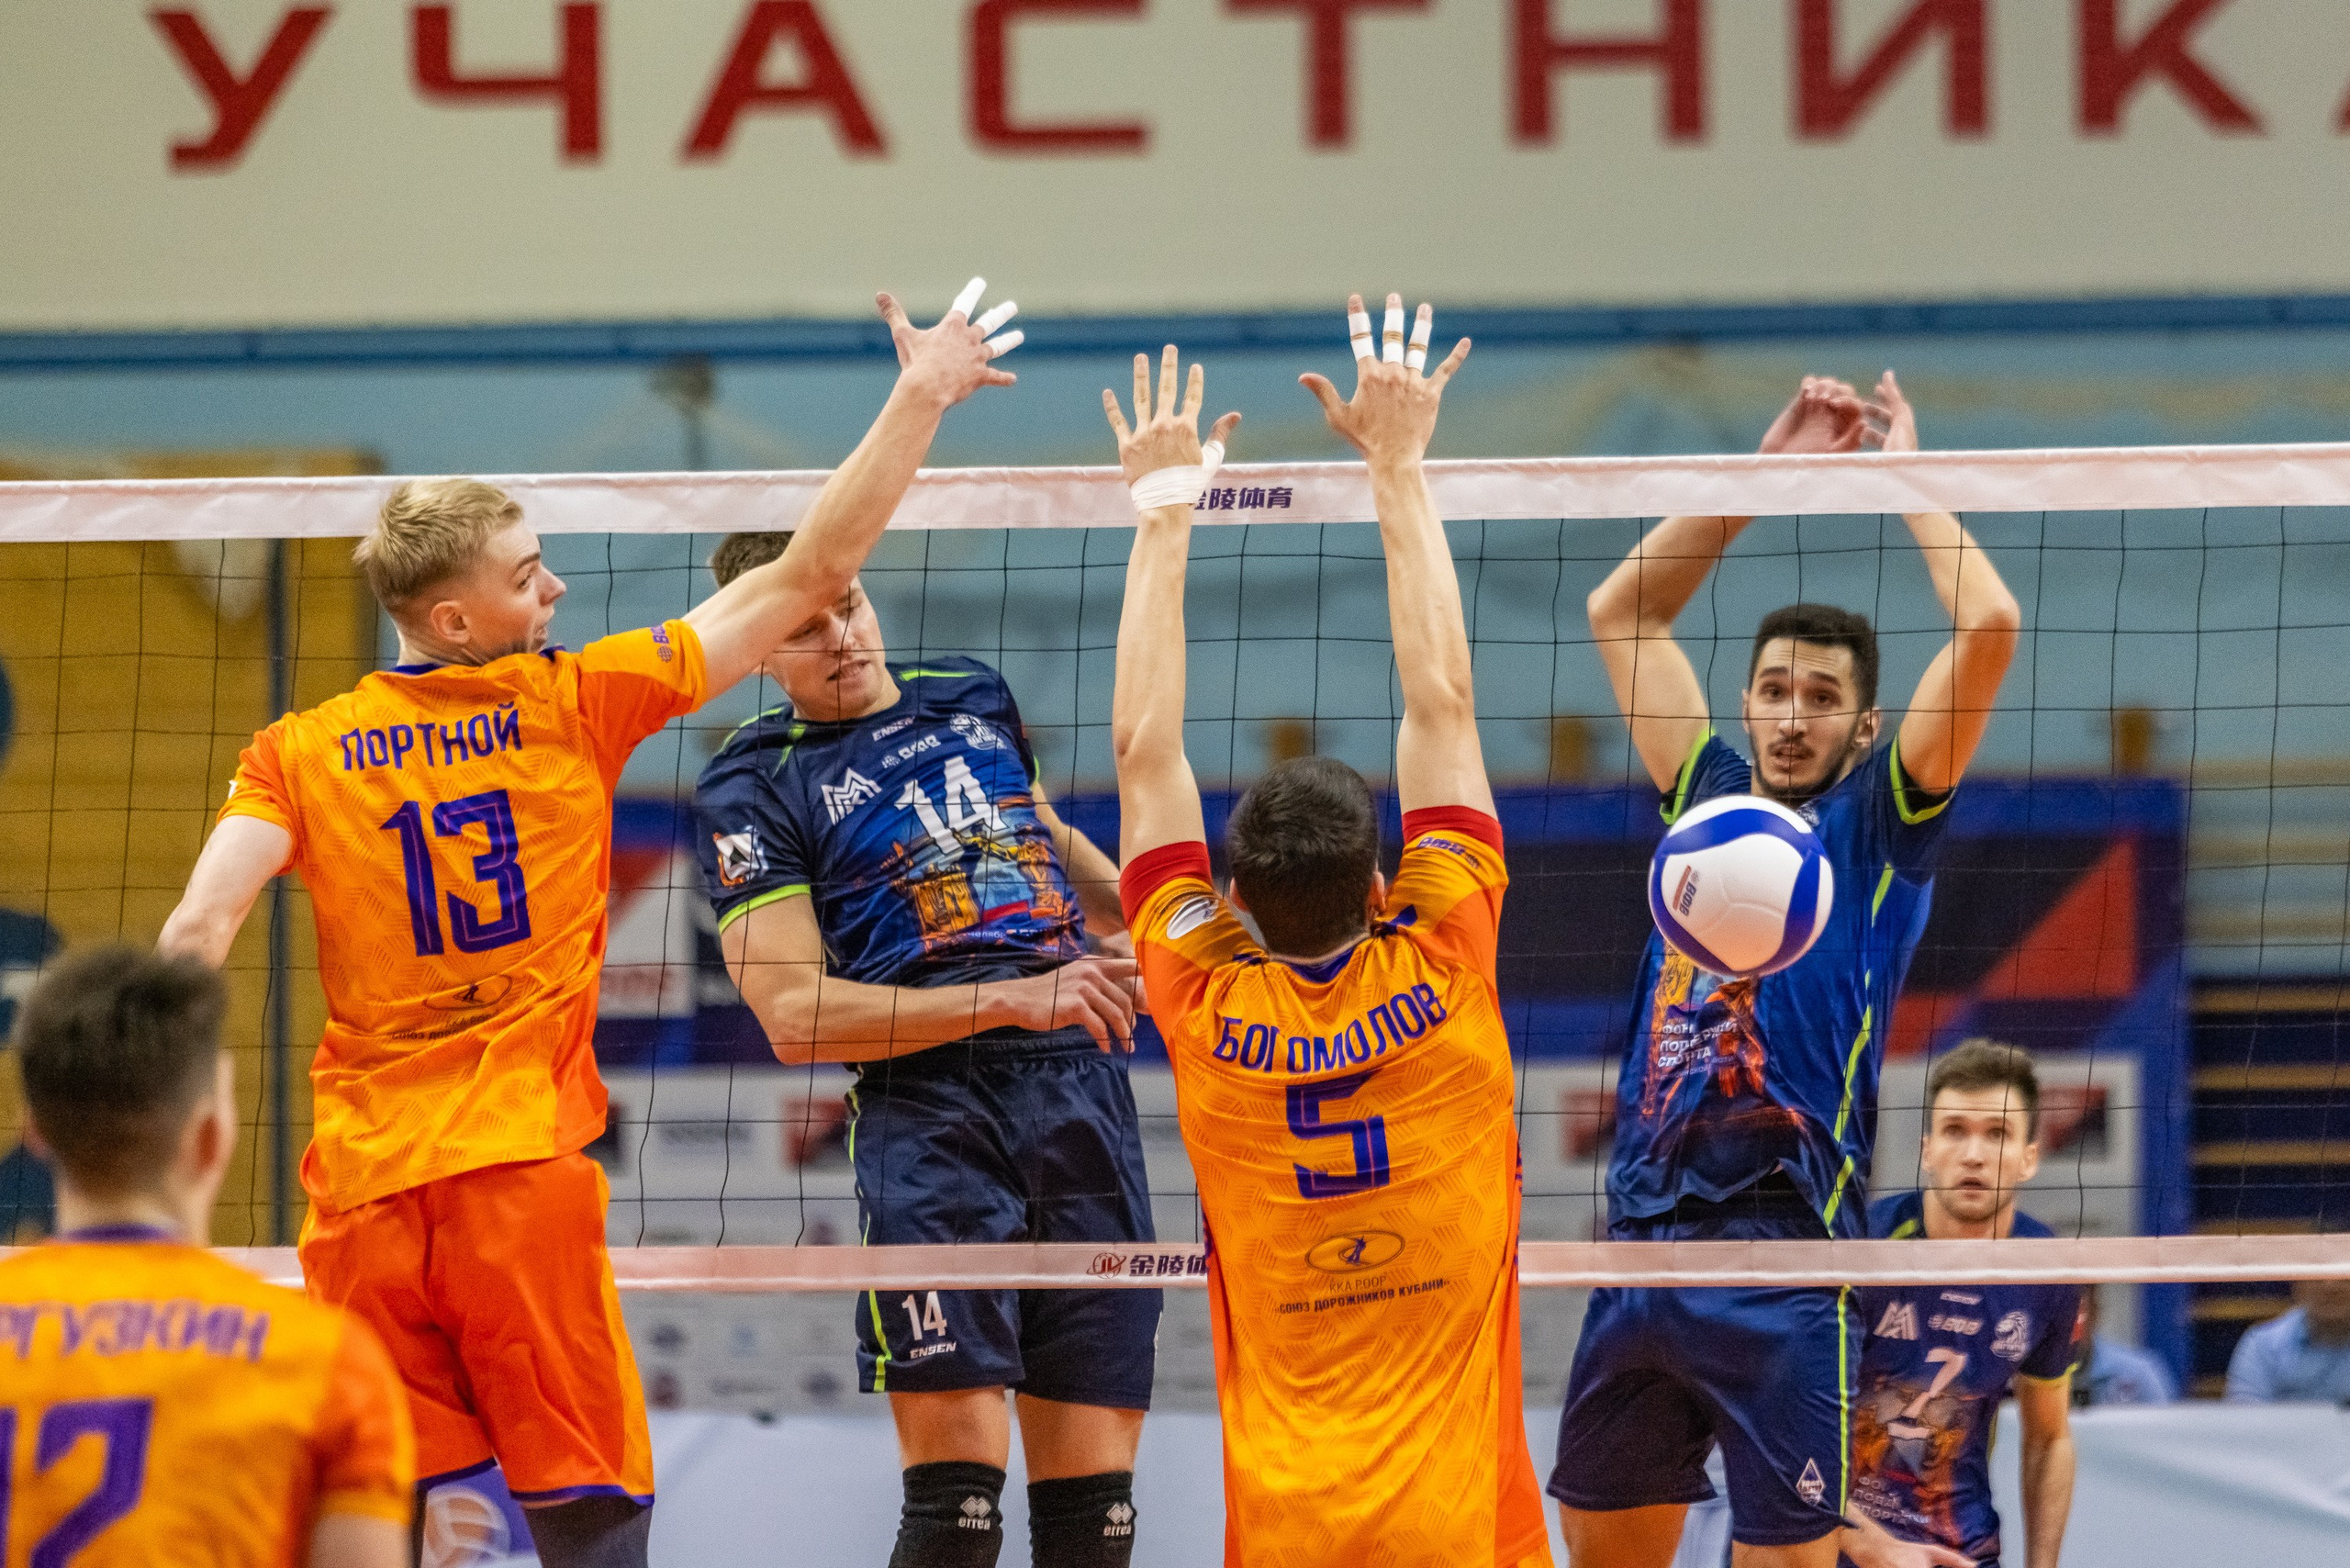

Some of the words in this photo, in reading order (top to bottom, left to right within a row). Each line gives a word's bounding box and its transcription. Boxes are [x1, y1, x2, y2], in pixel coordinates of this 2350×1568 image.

[151, 0, 2350, 173] УЧАСТНИК
[341, 701, 522, 771] ПОРТНОЙ
[894, 756, 1009, 854] 14
[379, 789, 532, 957] 13
[1213, 982, 1448, 1074] БОГОМОЛОВ
[1662, 1024, 1695, 1035] ФОН
[1285, 1068, 1391, 1200] 5
[901, 1290, 947, 1341] 14
[1314, 1288, 1395, 1313] ДОРОЖНИКОВ
[910, 1341, 957, 1359] ENSEN
[1900, 1347, 1968, 1419] 7
